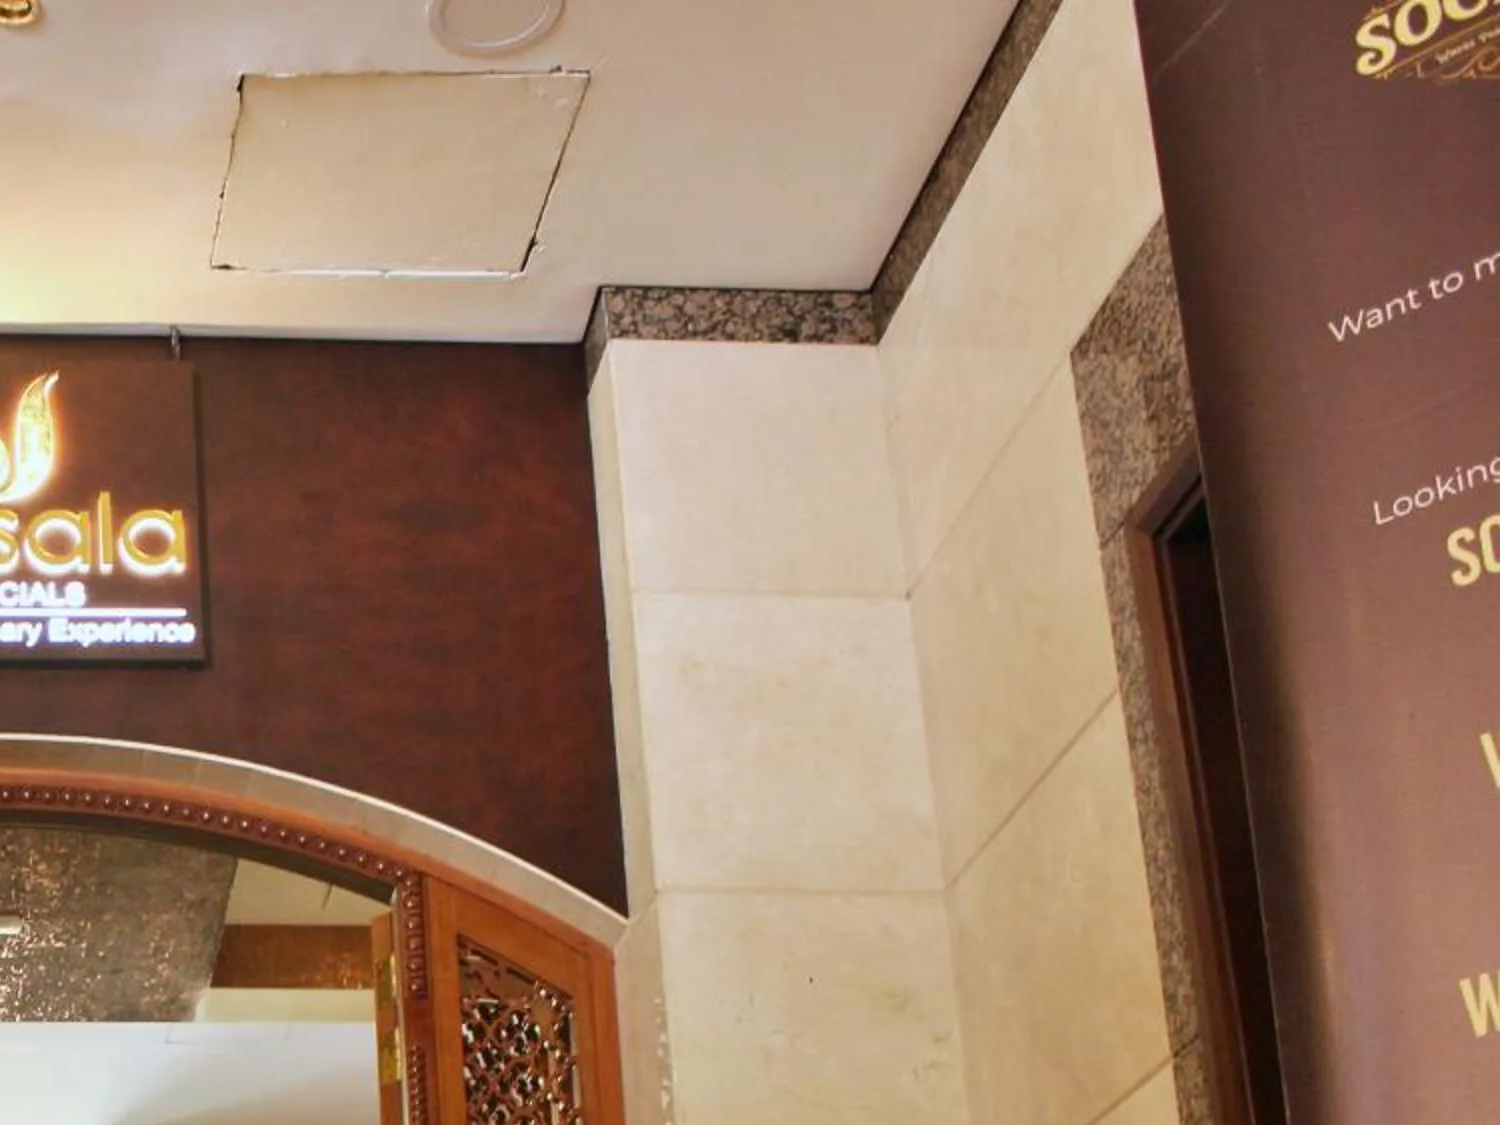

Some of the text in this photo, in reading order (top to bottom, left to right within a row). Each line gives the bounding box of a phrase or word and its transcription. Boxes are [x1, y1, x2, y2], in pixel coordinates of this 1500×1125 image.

[1328, 288, 1422, 342] Want
[1428, 271, 1464, 300] to
[48, 616, 197, 648] Experience
